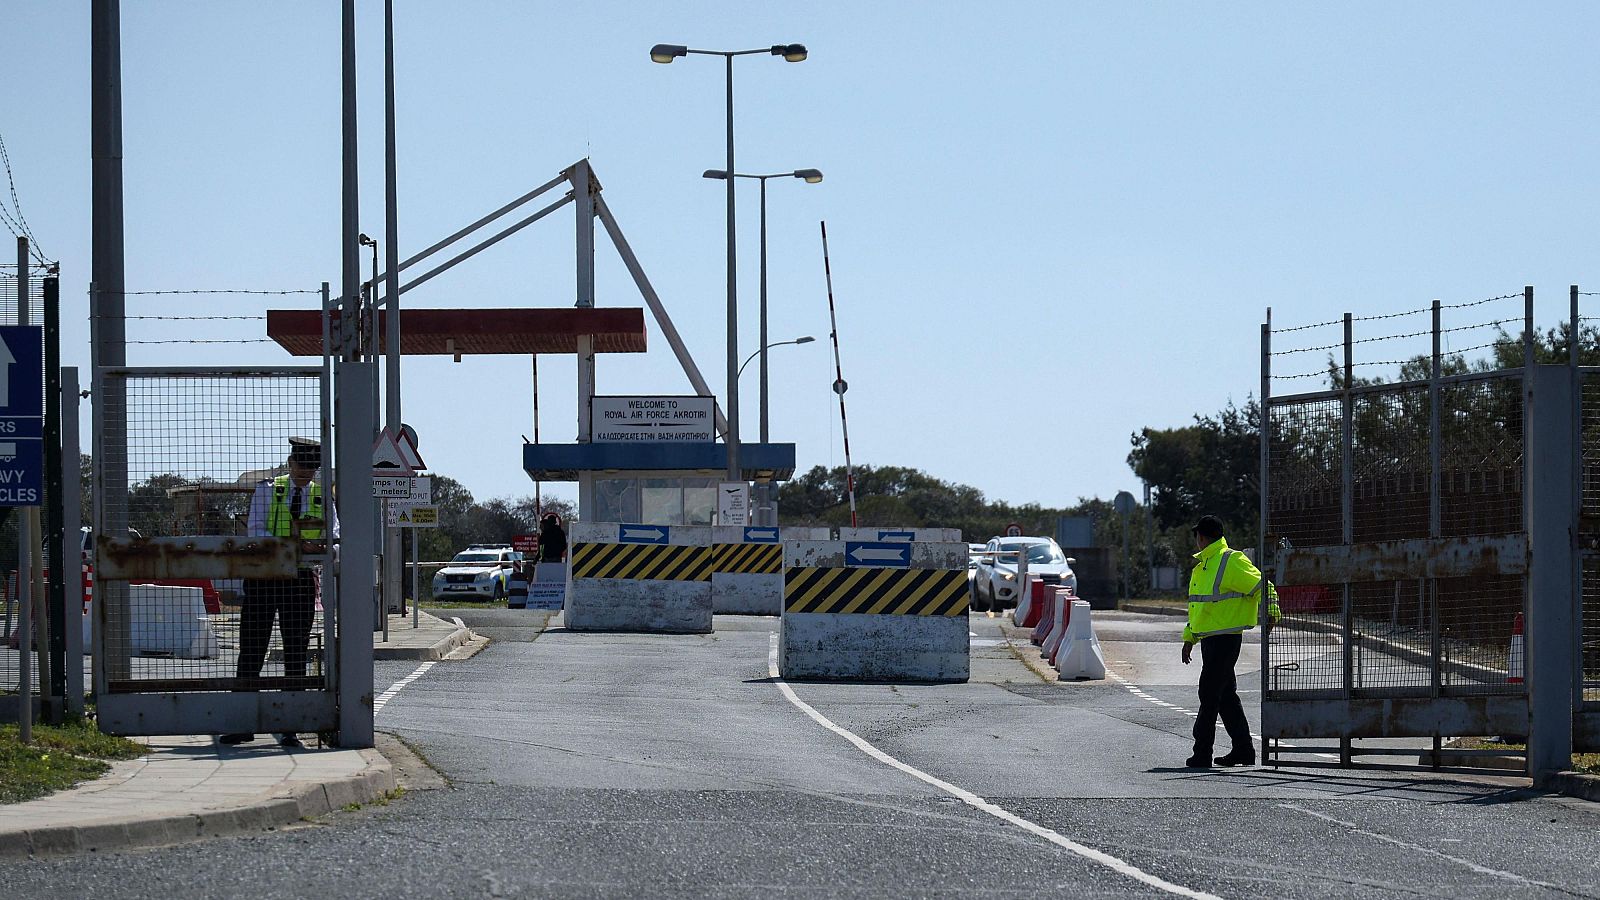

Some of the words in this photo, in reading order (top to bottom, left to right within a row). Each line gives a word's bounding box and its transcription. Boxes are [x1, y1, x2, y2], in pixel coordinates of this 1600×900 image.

[628, 400, 666, 409] WELCOME
[668, 400, 678, 409] TO
[604, 410, 627, 419] ROYAL
[631, 410, 643, 419] AIR
[646, 410, 670, 419] FORCE
[674, 410, 707, 419] AKROTIRI
[0, 488, 37, 502] CLES
